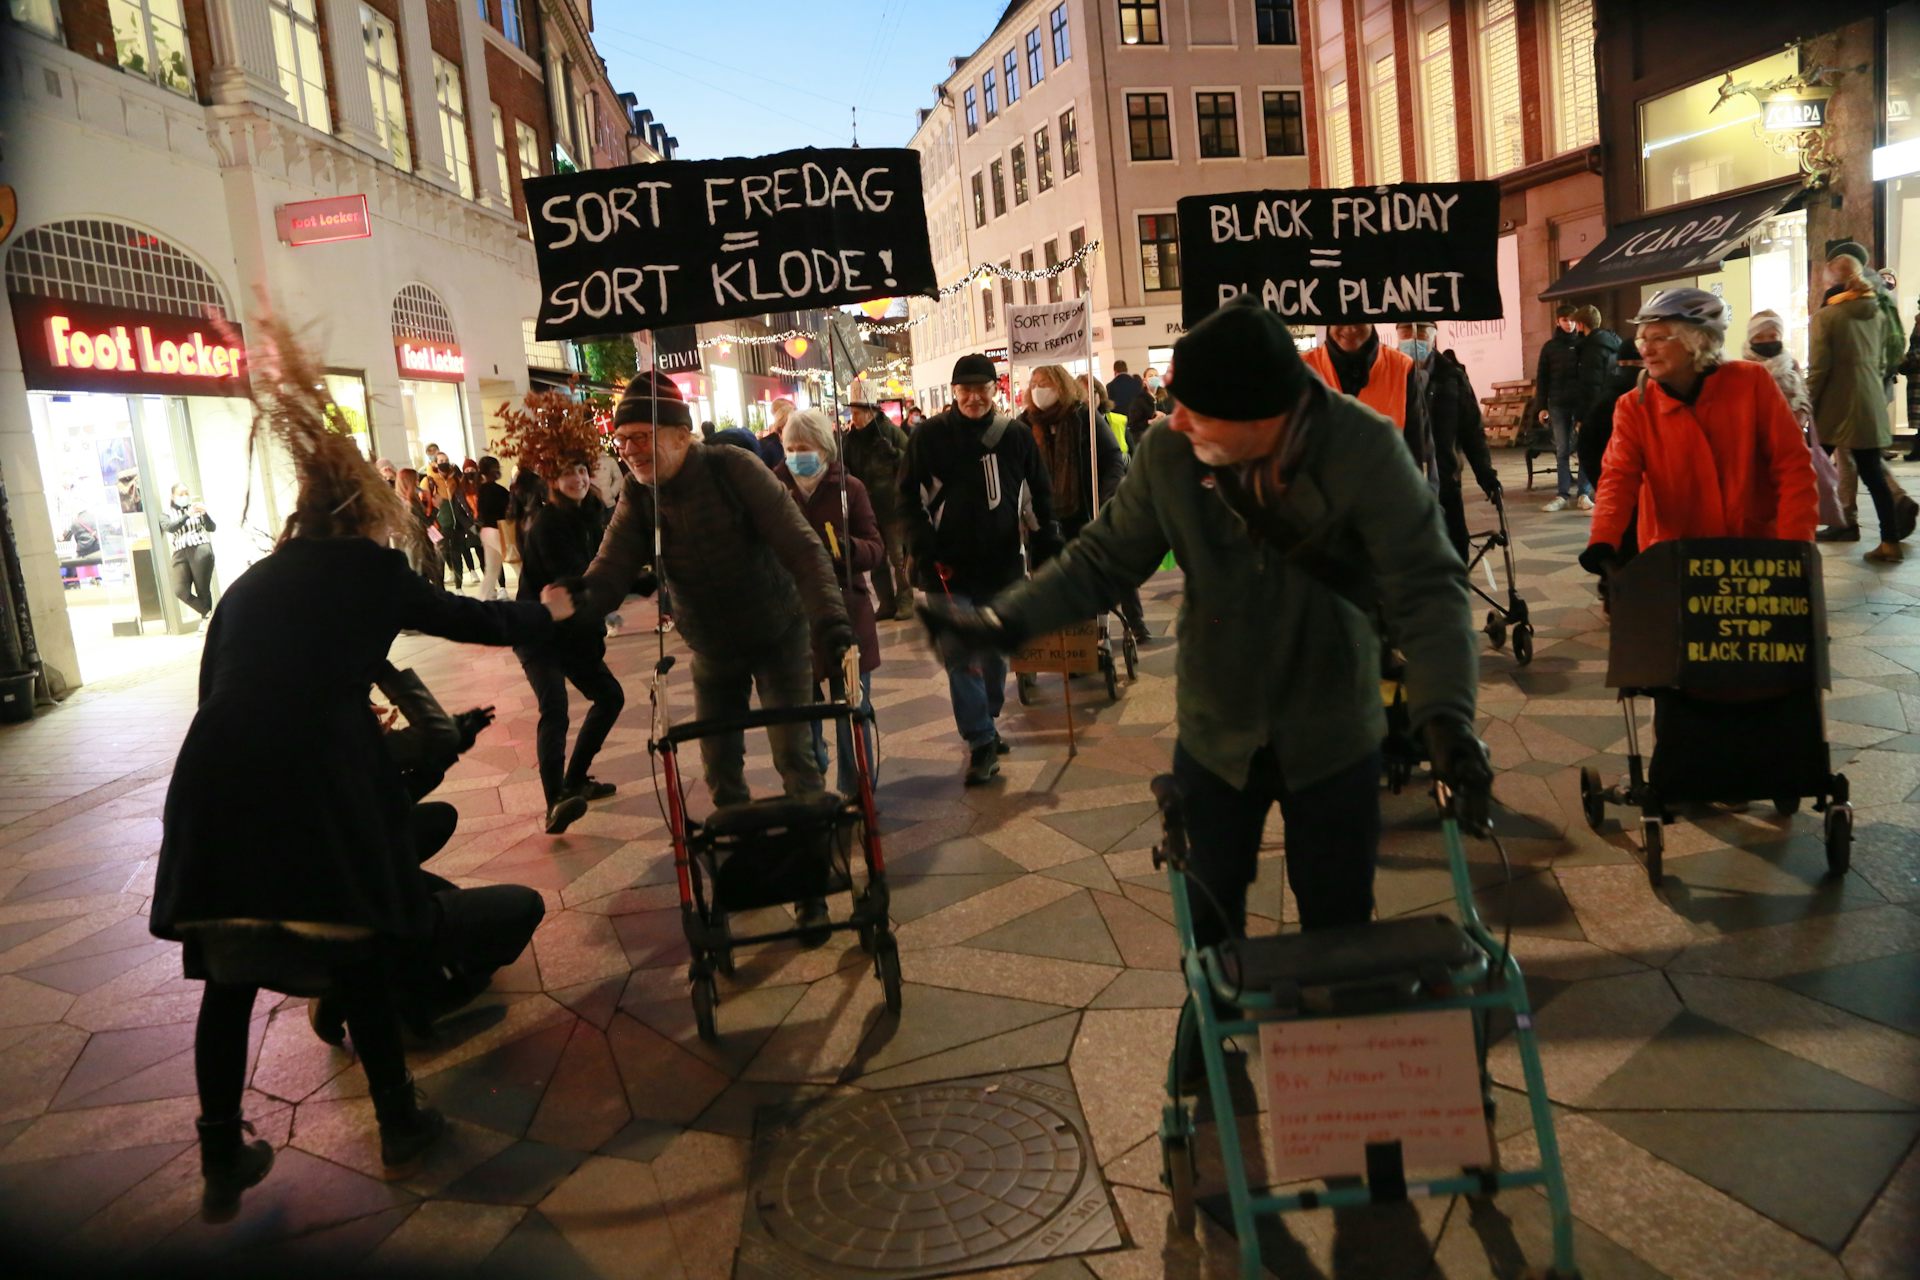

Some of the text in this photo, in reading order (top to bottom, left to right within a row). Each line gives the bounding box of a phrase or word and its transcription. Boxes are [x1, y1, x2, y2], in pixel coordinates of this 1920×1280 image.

[541, 162, 894, 249] SORT FREDAG
[1209, 186, 1459, 243] BLACK FRIDAY
[320, 212, 358, 226] Locker
[1599, 211, 1741, 263] SCARPA
[545, 249, 898, 325] SORT KLODE!
[1339, 272, 1464, 315] PLANET
[1014, 313, 1049, 329] SORT
[46, 316, 241, 378] Foot Locker
[1013, 330, 1084, 354] SORT FREMTID
[403, 343, 465, 373] Foot Locker
[1688, 559, 1801, 577] RED KLODEN
[1719, 578, 1771, 595] STOP
[1688, 596, 1809, 615] OVERFORBRUG
[1719, 620, 1772, 637] STOP
[1688, 642, 1807, 662] BLACK FRIDAY
